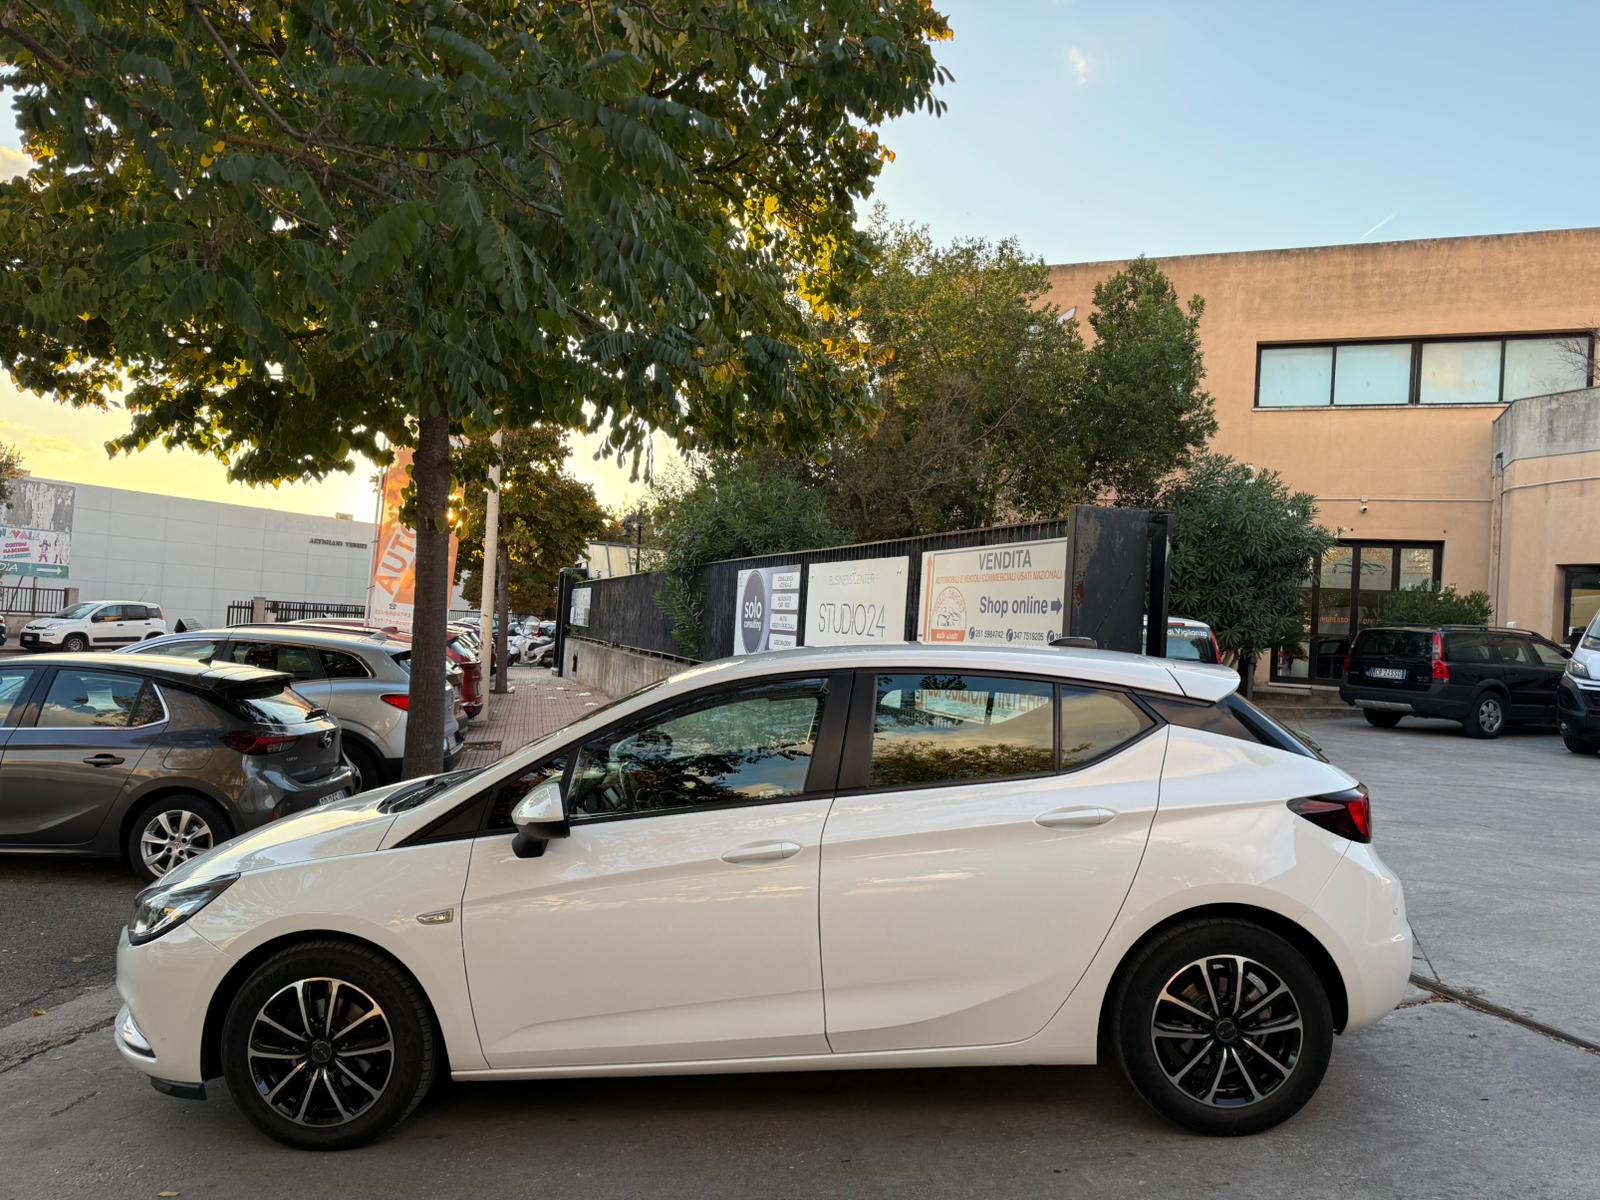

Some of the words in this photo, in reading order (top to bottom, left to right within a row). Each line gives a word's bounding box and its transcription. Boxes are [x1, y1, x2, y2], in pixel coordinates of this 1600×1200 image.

[979, 549, 1032, 571] VENDITA
[1033, 569, 1063, 580] NAZIONALI
[744, 595, 762, 619] solo
[980, 595, 1008, 618] Shop
[1012, 596, 1048, 614] online
[744, 620, 762, 631] consulting
[818, 603, 886, 638] STUDIO24
